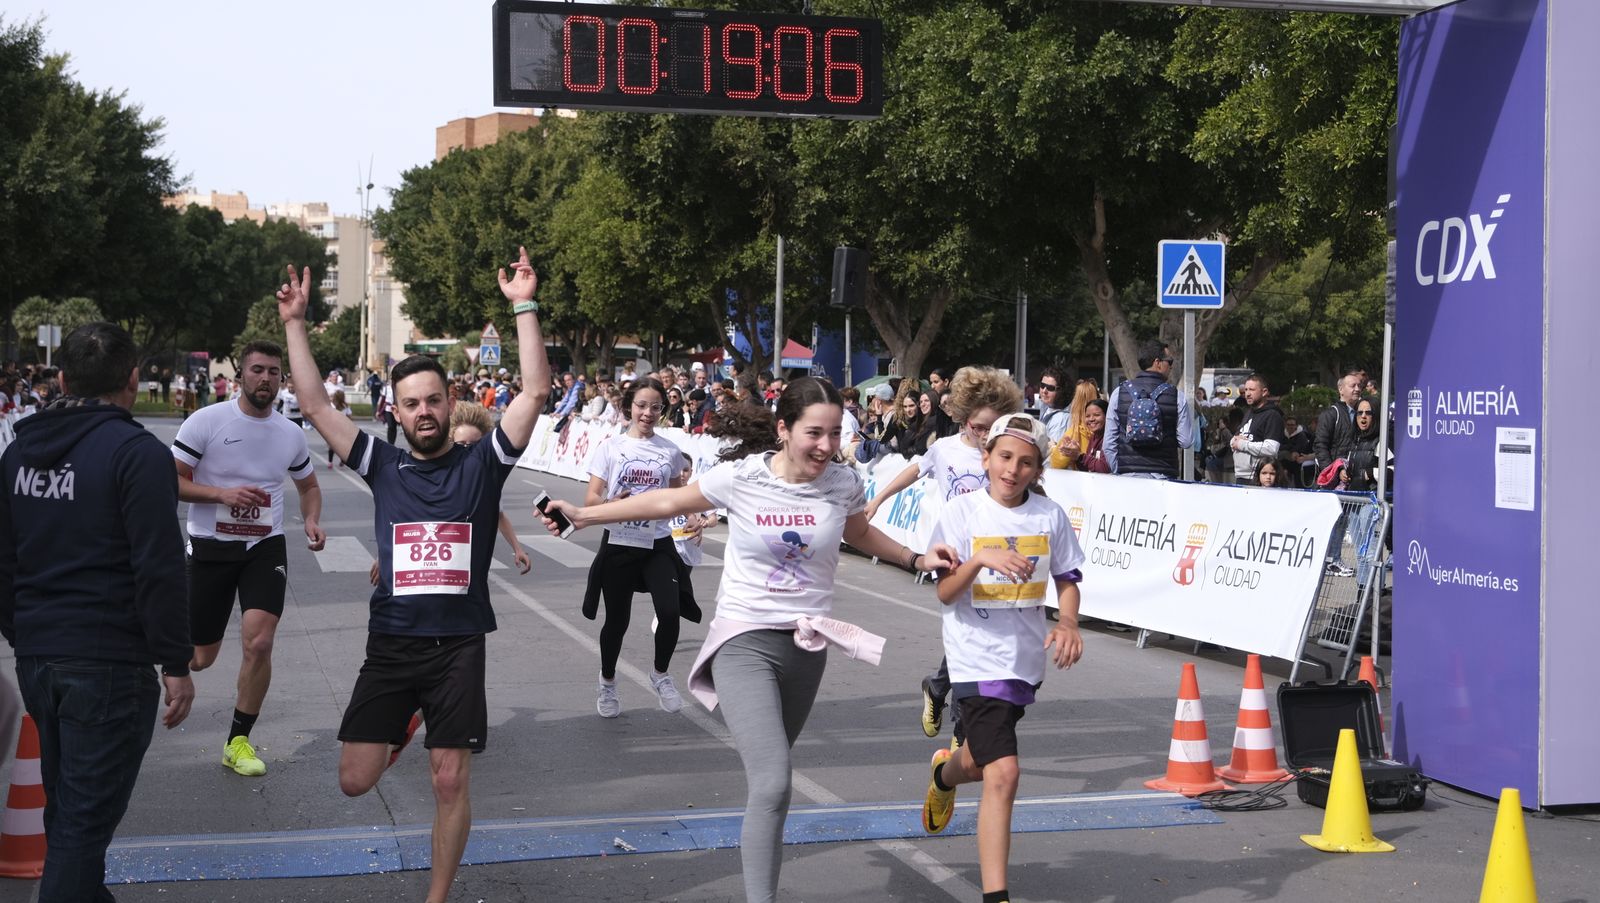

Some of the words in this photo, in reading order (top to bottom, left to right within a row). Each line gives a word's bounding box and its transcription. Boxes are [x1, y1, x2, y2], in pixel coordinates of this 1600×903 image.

[563, 15, 864, 103] 00:19:06
[1435, 385, 1520, 415] ALMERÍA
[1435, 419, 1475, 435] CIUDAD
[622, 476, 660, 485] RUNNER
[631, 469, 653, 477] MINI
[230, 505, 260, 519] 820
[756, 514, 817, 526] MUJER
[1095, 513, 1176, 552] ALMERÍA
[410, 543, 452, 562] 826
[1091, 546, 1132, 570] CIUDAD
[1216, 527, 1314, 568] ALMERÍA
[1214, 565, 1261, 590] CIUDAD
